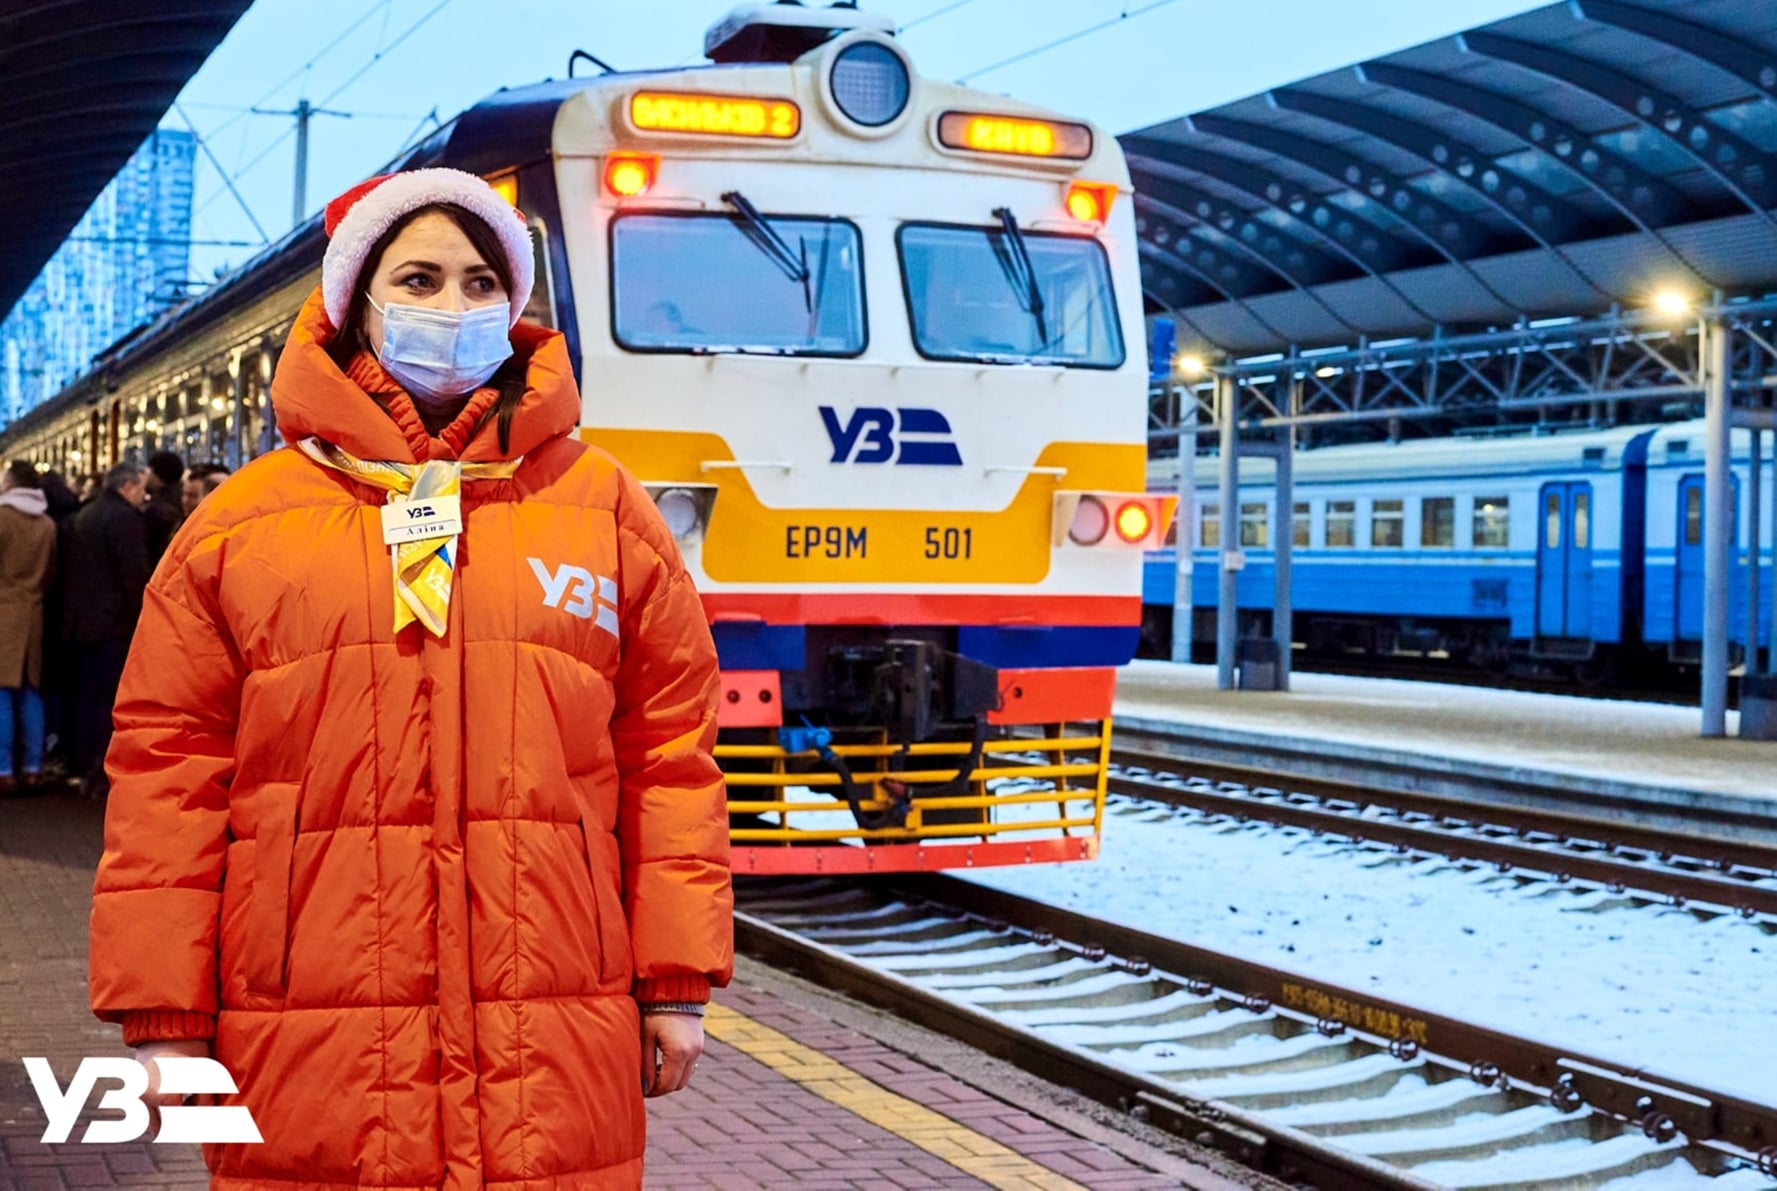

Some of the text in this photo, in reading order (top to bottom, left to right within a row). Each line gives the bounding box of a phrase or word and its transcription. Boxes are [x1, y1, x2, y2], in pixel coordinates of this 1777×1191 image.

[771, 104, 793, 138] 2
[785, 526, 972, 560] ЕР9М 501
